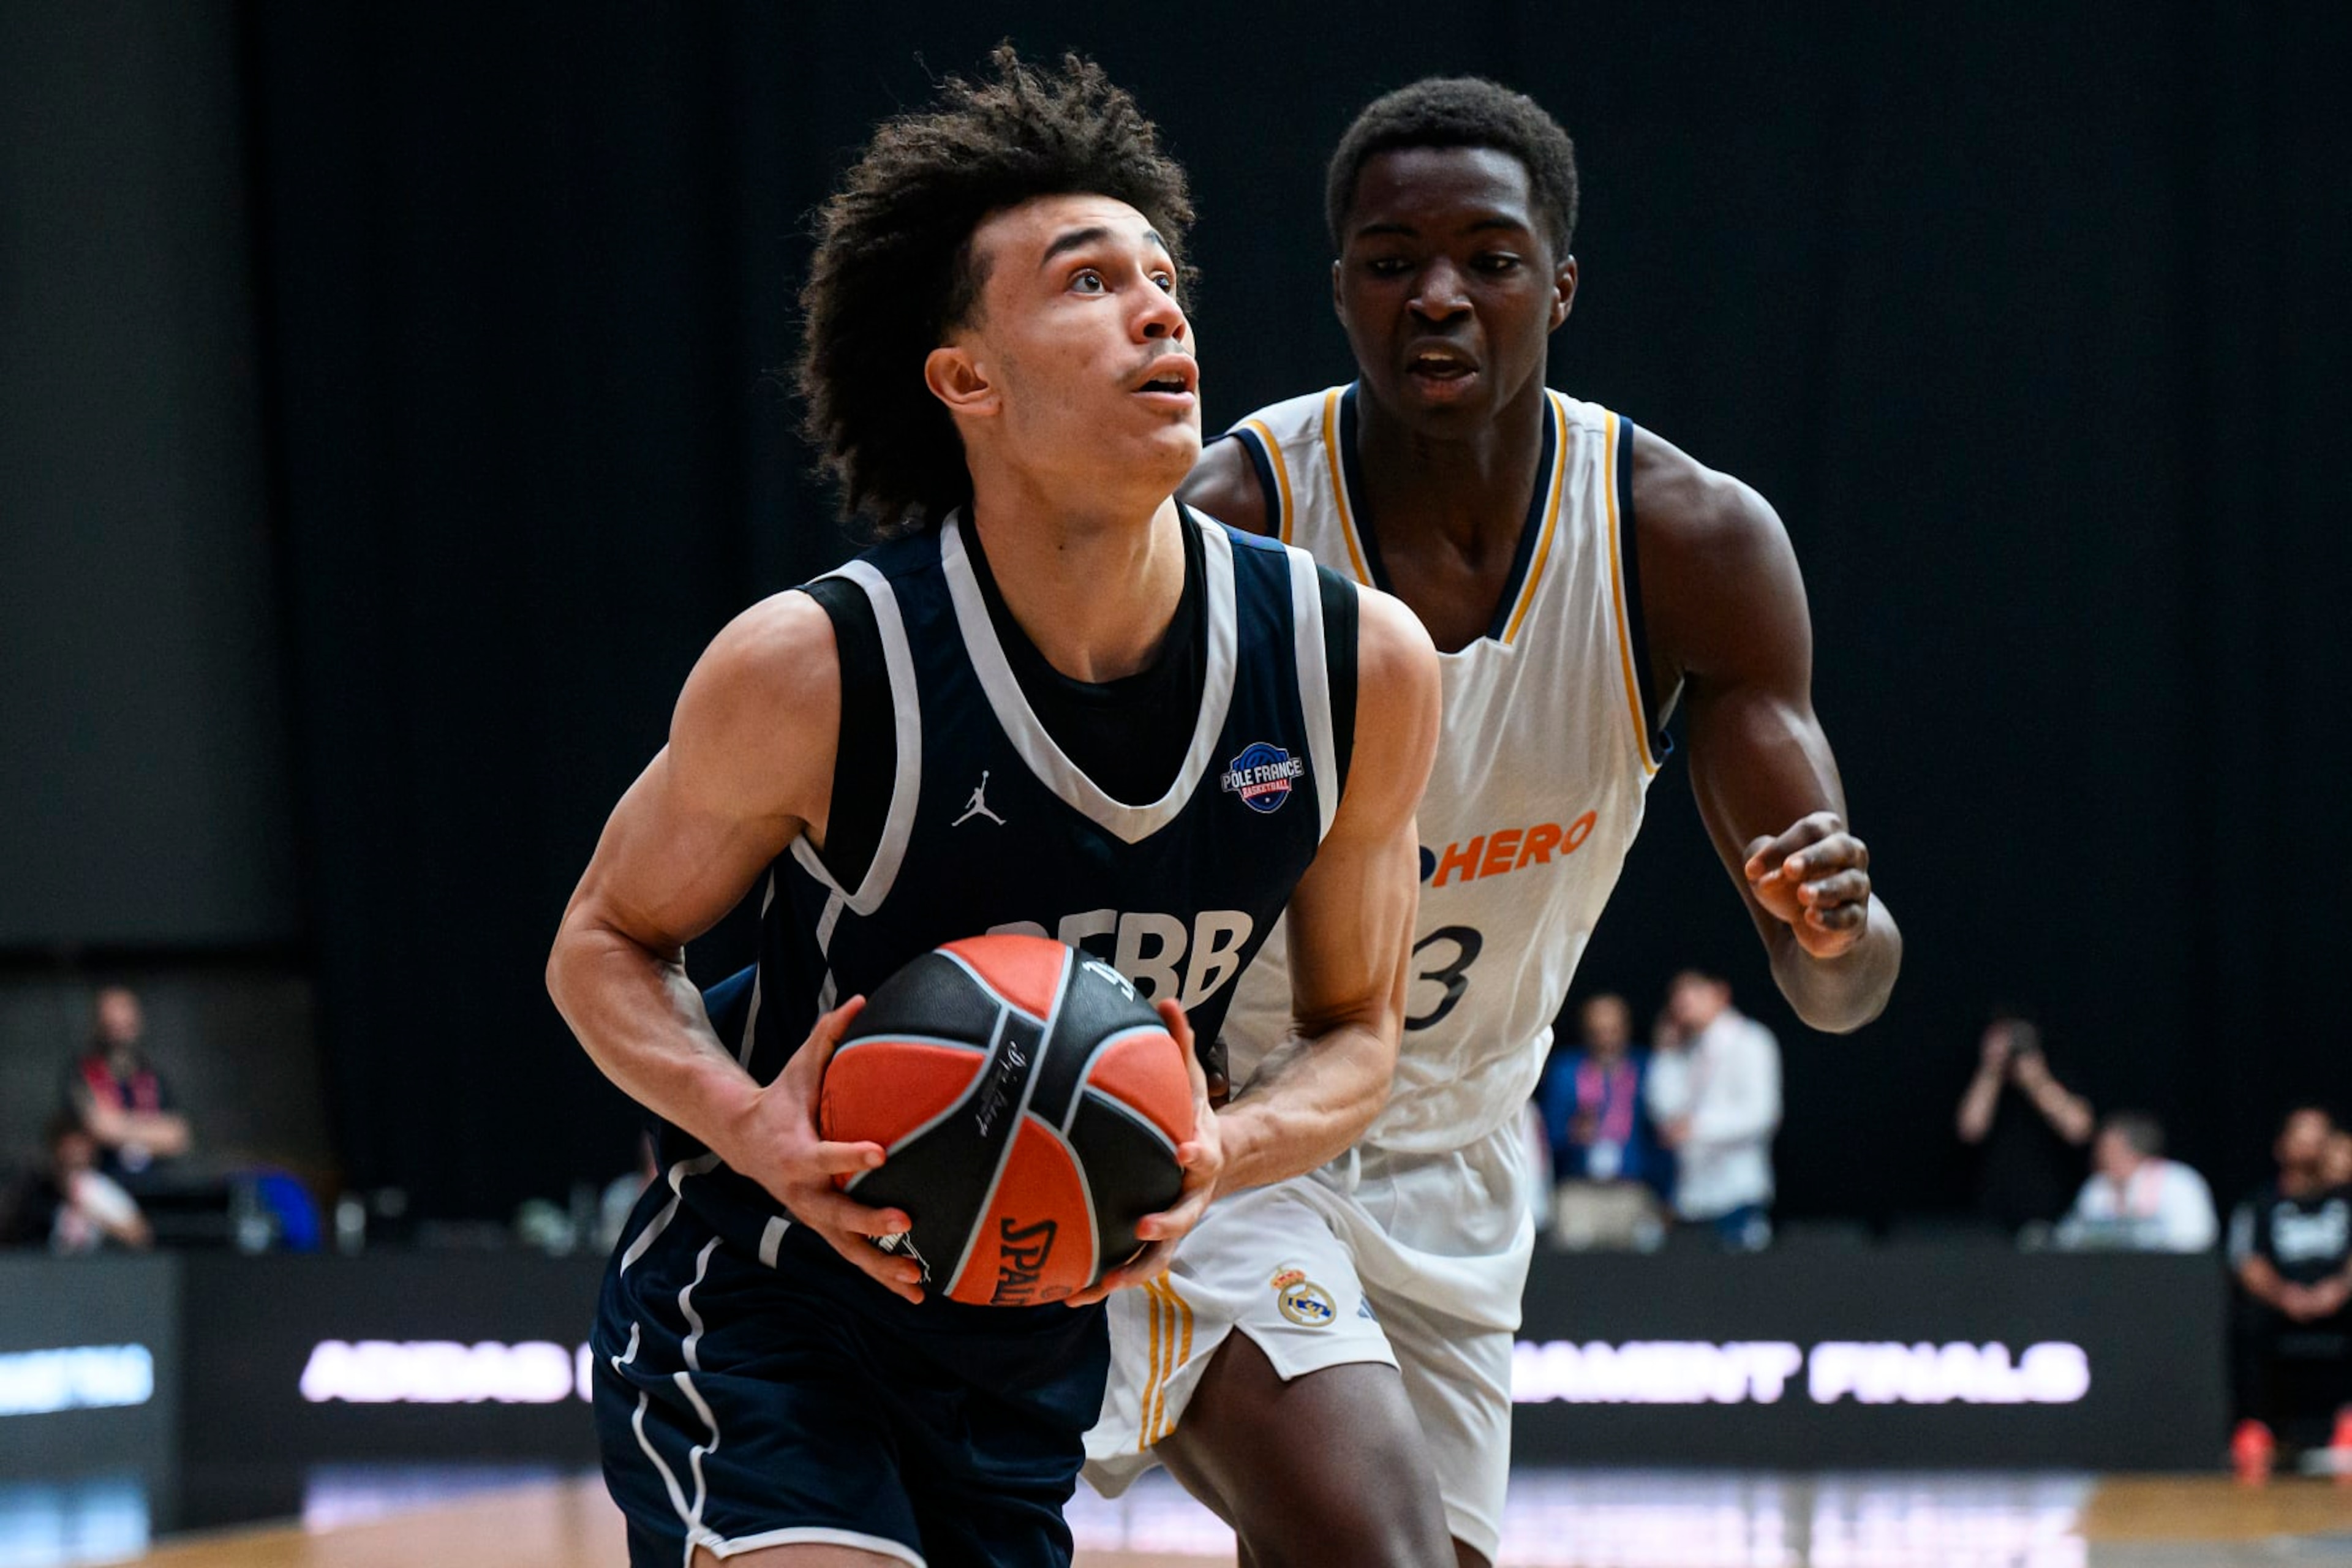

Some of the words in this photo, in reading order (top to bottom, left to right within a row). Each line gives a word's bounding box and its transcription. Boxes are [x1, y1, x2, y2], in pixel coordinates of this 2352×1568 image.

[1242, 778, 1289, 797] BASKETBALL
[1254, 760, 1303, 783] FRANCE
[986, 908, 1254, 1012] FBB
[1404, 925, 1483, 1030] 3
